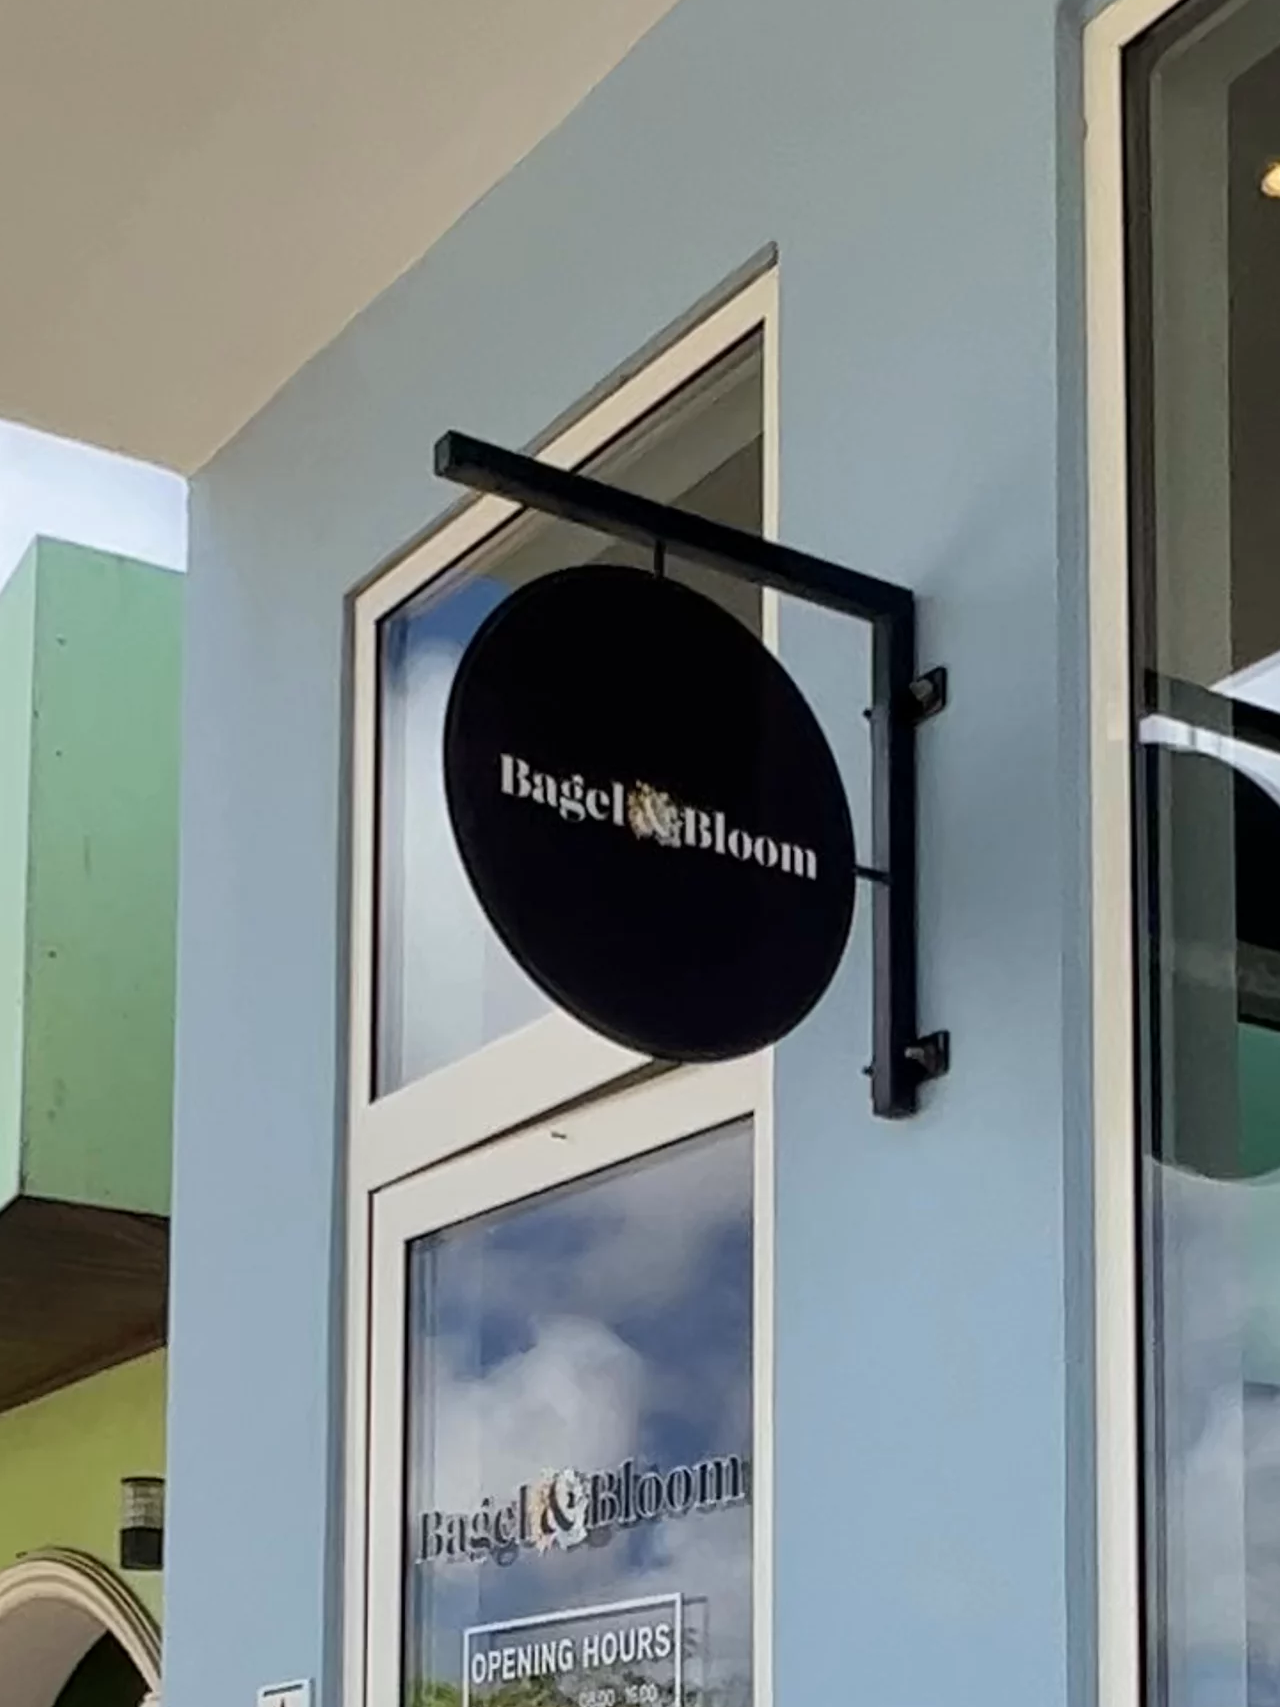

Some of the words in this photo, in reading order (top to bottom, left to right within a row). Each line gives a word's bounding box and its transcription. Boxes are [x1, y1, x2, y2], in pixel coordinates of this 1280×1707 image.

[500, 752, 625, 827] Bagel
[681, 806, 818, 881] Bloom
[415, 1484, 532, 1565] Bagel
[586, 1453, 747, 1530] Bloom
[471, 1638, 574, 1685] OPENING
[582, 1623, 671, 1669] HOURS
